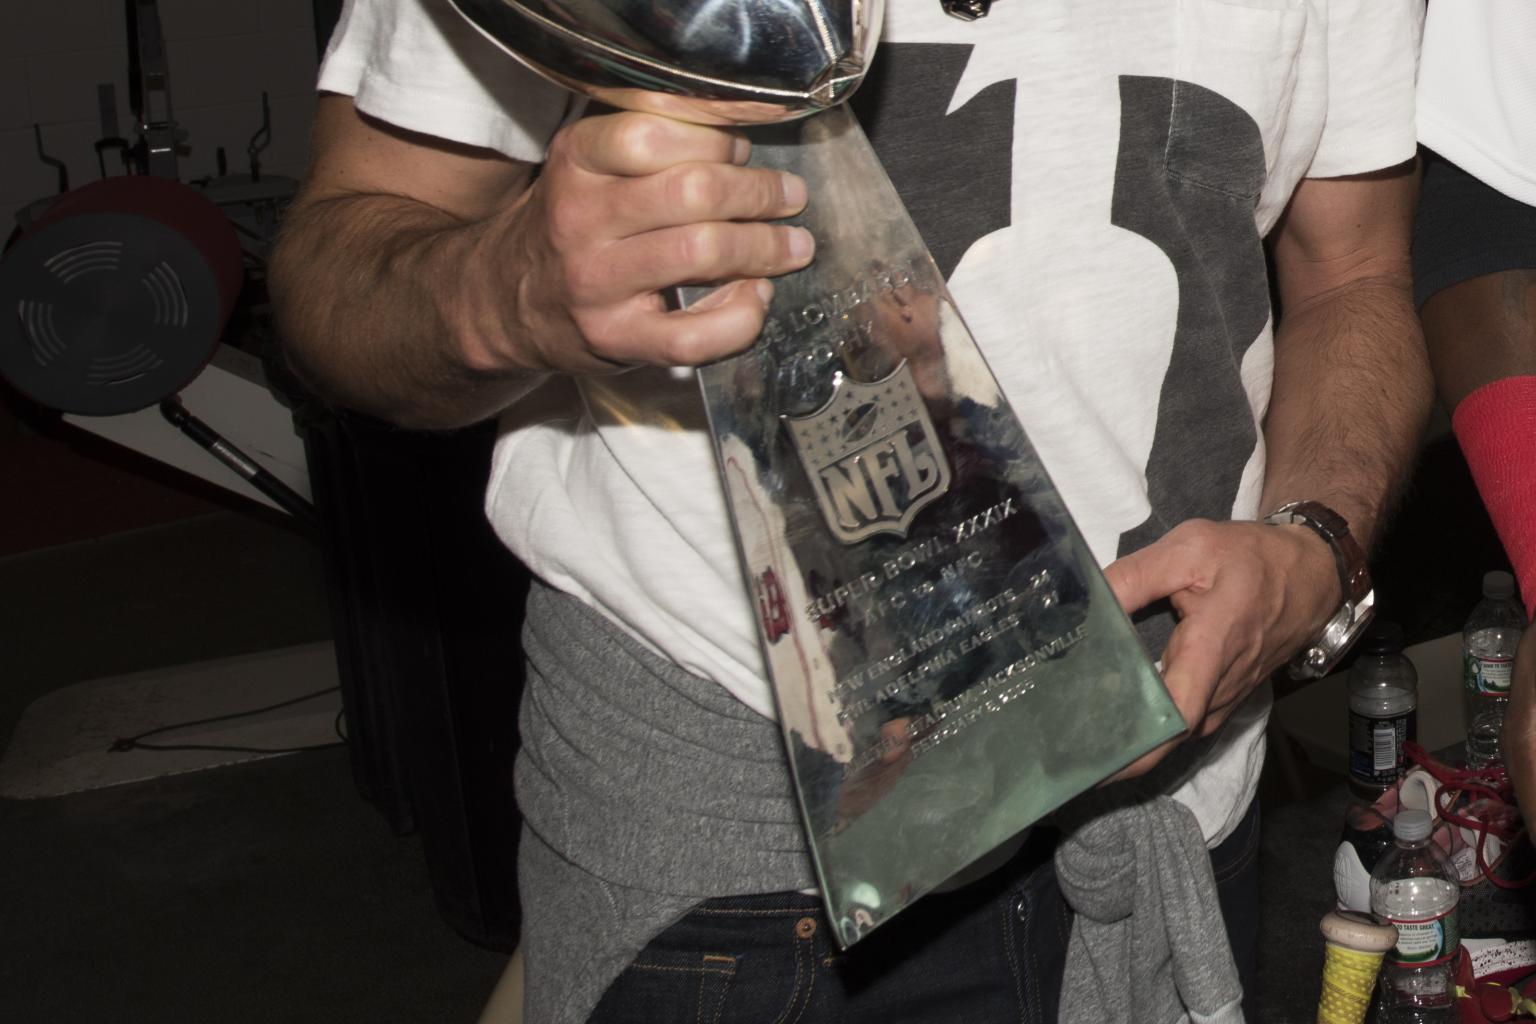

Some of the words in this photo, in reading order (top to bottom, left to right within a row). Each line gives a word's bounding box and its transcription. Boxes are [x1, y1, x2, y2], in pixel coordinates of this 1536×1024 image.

[817, 426, 943, 527] NFL
[801, 568, 882, 623] SUPER
[880, 530, 951, 580] BOWL
[948, 495, 1019, 545] XXXIX
[938, 548, 986, 584] NFC
[864, 626, 947, 680] ENGLAND
[956, 611, 1021, 655] EAGLES
[973, 622, 1090, 698] JACKSONVILLE
